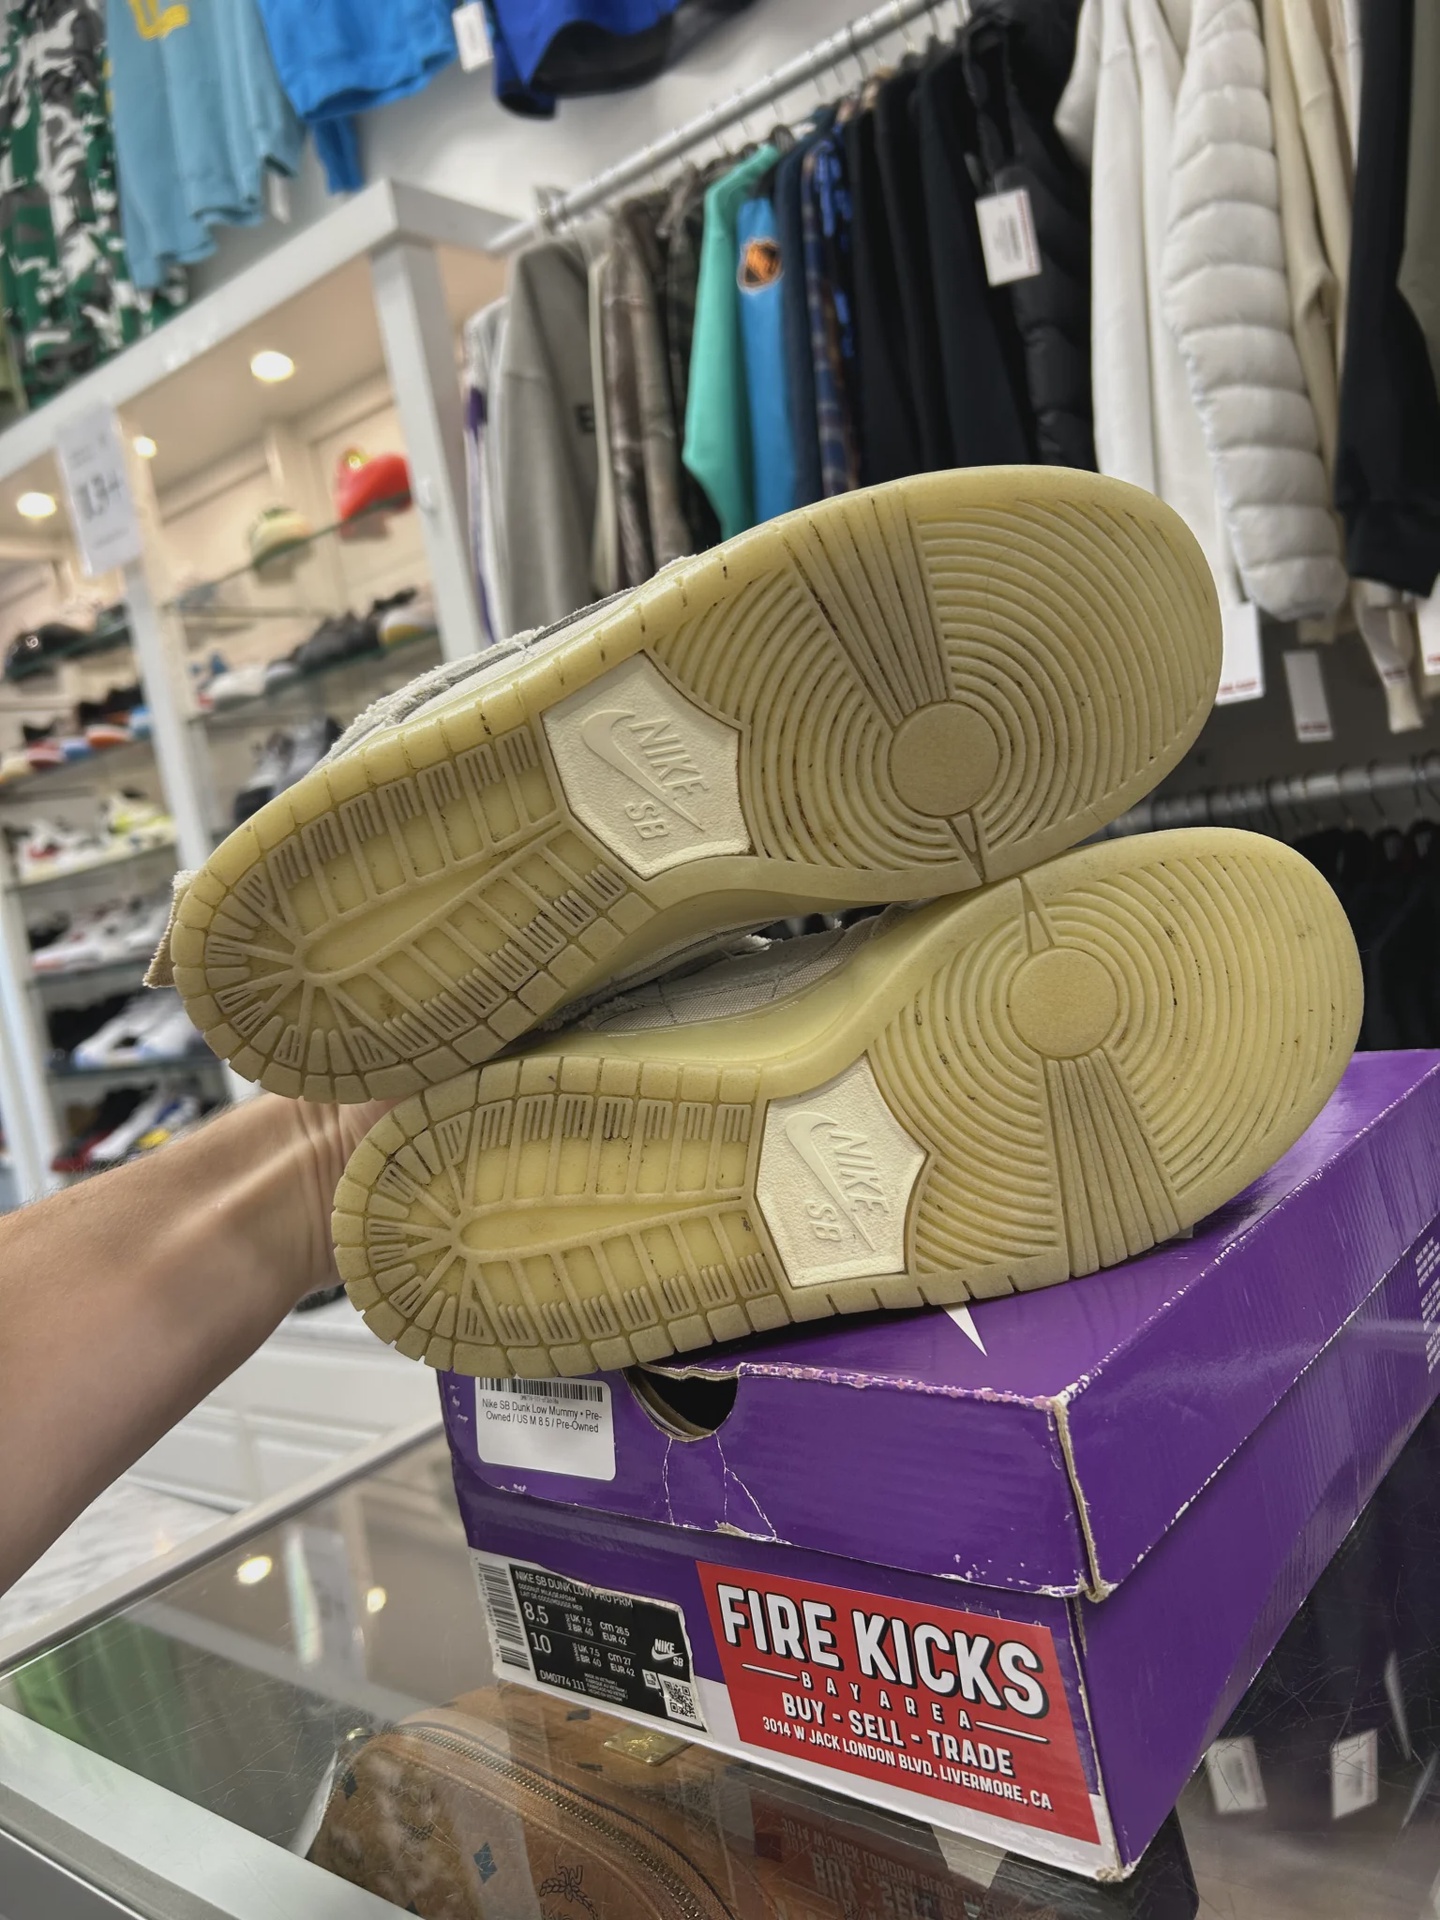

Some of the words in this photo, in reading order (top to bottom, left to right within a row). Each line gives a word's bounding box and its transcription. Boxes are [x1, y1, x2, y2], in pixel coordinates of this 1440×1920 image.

[626, 718, 710, 799] NIKE
[624, 801, 670, 841] SB
[827, 1130, 890, 1213] NIKE
[804, 1200, 841, 1242] SB
[482, 1398, 498, 1409] Nike
[500, 1401, 510, 1411] SB
[512, 1401, 531, 1413] Dunk
[532, 1405, 547, 1415] Low
[549, 1406, 579, 1420] Mummy
[585, 1409, 602, 1421] Pre-
[486, 1410, 511, 1422] Owned
[516, 1414, 528, 1424] US
[530, 1415, 537, 1425] M
[556, 1418, 599, 1433] Pre-Owned
[515, 1570, 535, 1583] NIKE
[535, 1575, 547, 1587] SB
[548, 1578, 572, 1594] DUNK
[572, 1584, 593, 1598] LOW
[594, 1592, 612, 1603] PRO
[613, 1595, 634, 1608] PRM
[523, 1601, 549, 1624] 8.5
[570, 1613, 581, 1624] UK
[581, 1616, 593, 1627] 7.5
[572, 1623, 583, 1634] BR
[585, 1626, 594, 1637] 40
[600, 1621, 614, 1631] cm
[530, 1632, 552, 1654] 10
[577, 1643, 589, 1654] UK
[589, 1646, 601, 1657] 7.5
[602, 1631, 618, 1643] EUR
[618, 1635, 628, 1646] 42
[654, 1638, 675, 1654] NIKE
[717, 1583, 842, 1669] FIRE
[851, 1610, 1047, 1717] KICKS
[580, 1654, 591, 1664] BR
[592, 1657, 602, 1667] 40
[607, 1652, 622, 1662] cm
[622, 1657, 631, 1666] 27
[610, 1662, 626, 1674] EUR
[626, 1667, 636, 1677] 42
[672, 1656, 684, 1667] SB
[539, 1669, 572, 1687] DM0774
[572, 1680, 587, 1692] 111
[801, 1671, 860, 1701] BAY
[879, 1690, 971, 1729] AREA
[782, 1692, 824, 1725] BUY
[849, 1709, 905, 1747] SELL
[927, 1729, 1014, 1776] TRADE
[762, 1716, 791, 1736] 3014
[793, 1724, 805, 1740] W
[809, 1729, 841, 1750] JACK
[842, 1737, 896, 1766] LONDON
[898, 1753, 938, 1778] BLVD.
[939, 1764, 1028, 1805] LIVERMORE,
[1030, 1790, 1053, 1810] CA
